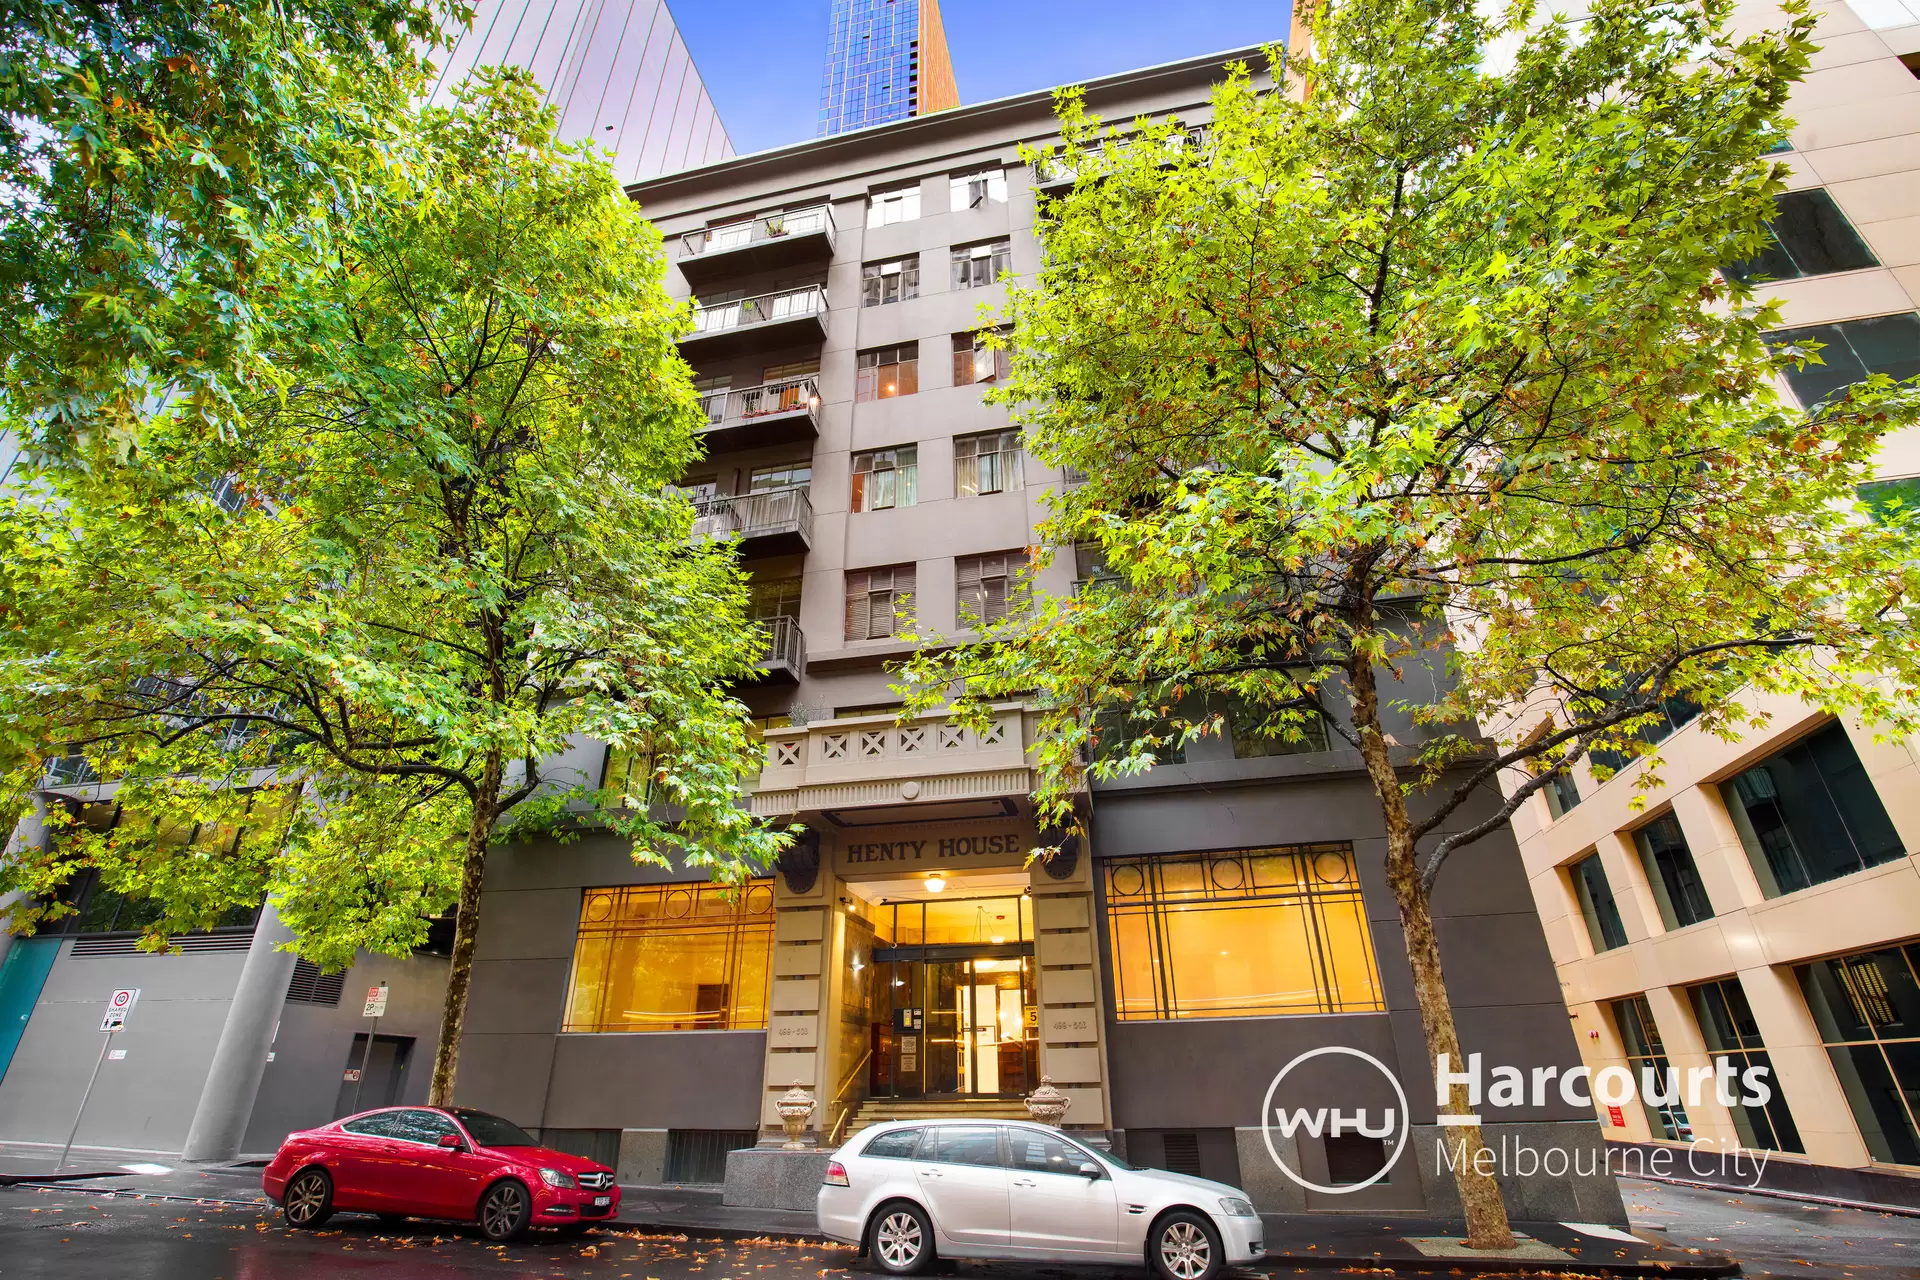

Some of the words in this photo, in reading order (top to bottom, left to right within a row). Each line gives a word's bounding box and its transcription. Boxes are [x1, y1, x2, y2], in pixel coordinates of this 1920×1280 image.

[846, 840, 928, 864] HENTY
[938, 834, 1020, 858] HOUSE
[118, 995, 126, 1003] 10
